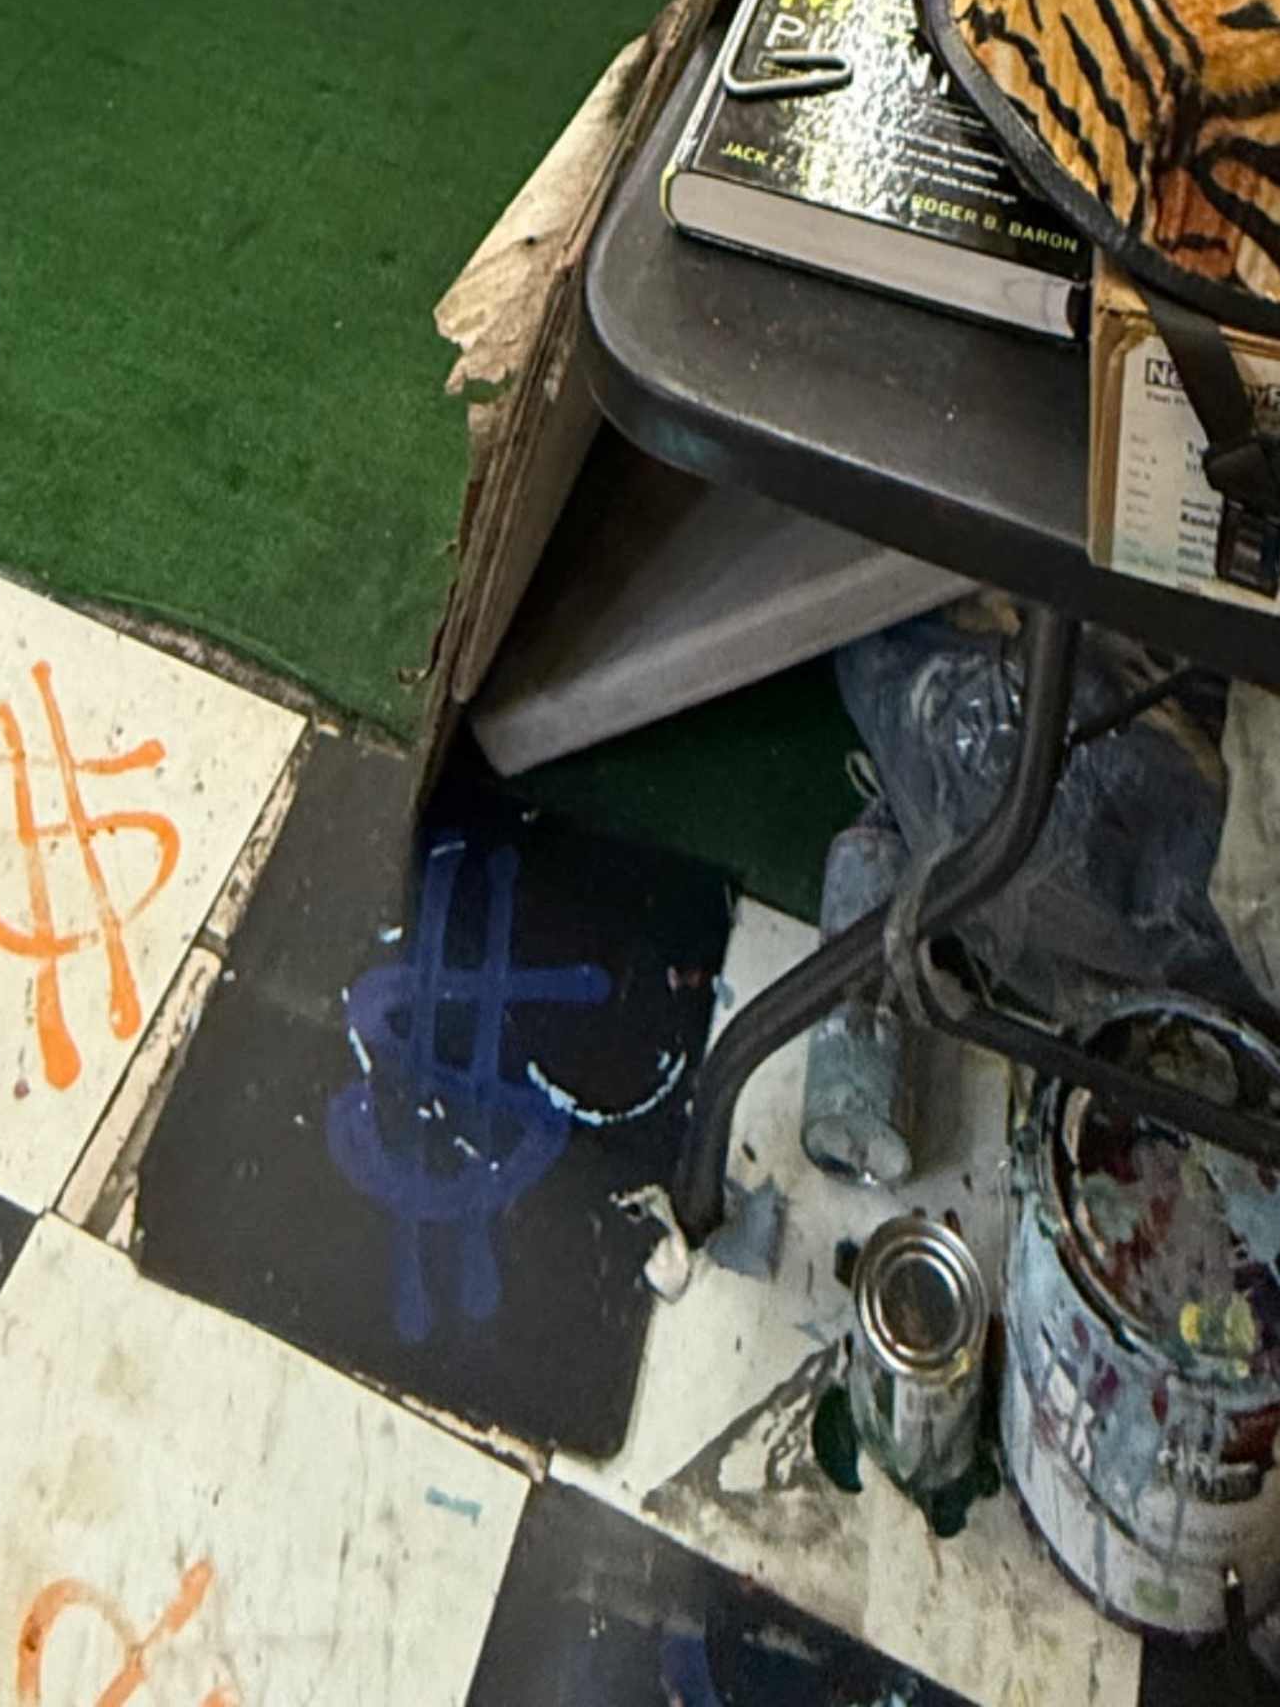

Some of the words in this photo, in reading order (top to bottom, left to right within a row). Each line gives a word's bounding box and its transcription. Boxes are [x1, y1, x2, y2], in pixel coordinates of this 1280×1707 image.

[720, 140, 769, 167] JACK
[911, 194, 978, 225] ROGER
[1008, 221, 1079, 254] BARON
